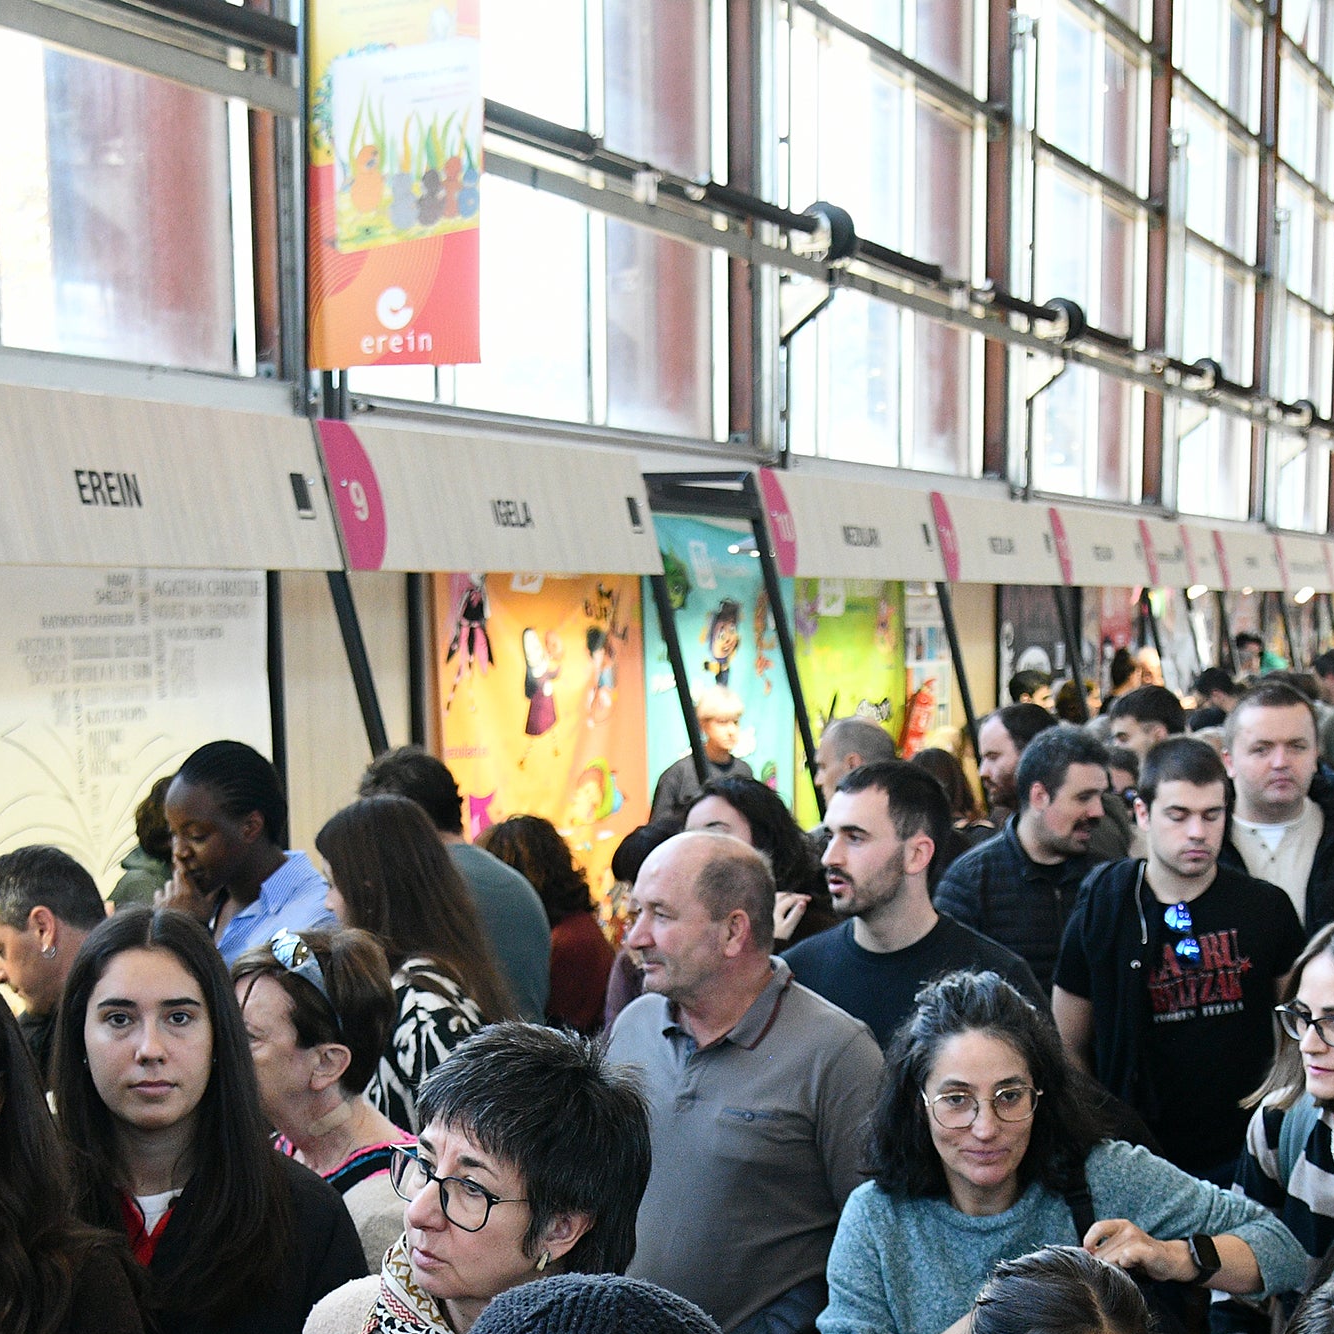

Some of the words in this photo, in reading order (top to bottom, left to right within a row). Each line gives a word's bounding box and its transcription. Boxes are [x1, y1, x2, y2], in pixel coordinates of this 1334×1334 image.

[361, 328, 433, 355] erein
[74, 469, 143, 508] EREIN
[349, 480, 369, 522] 9
[490, 499, 535, 528] IGELA
